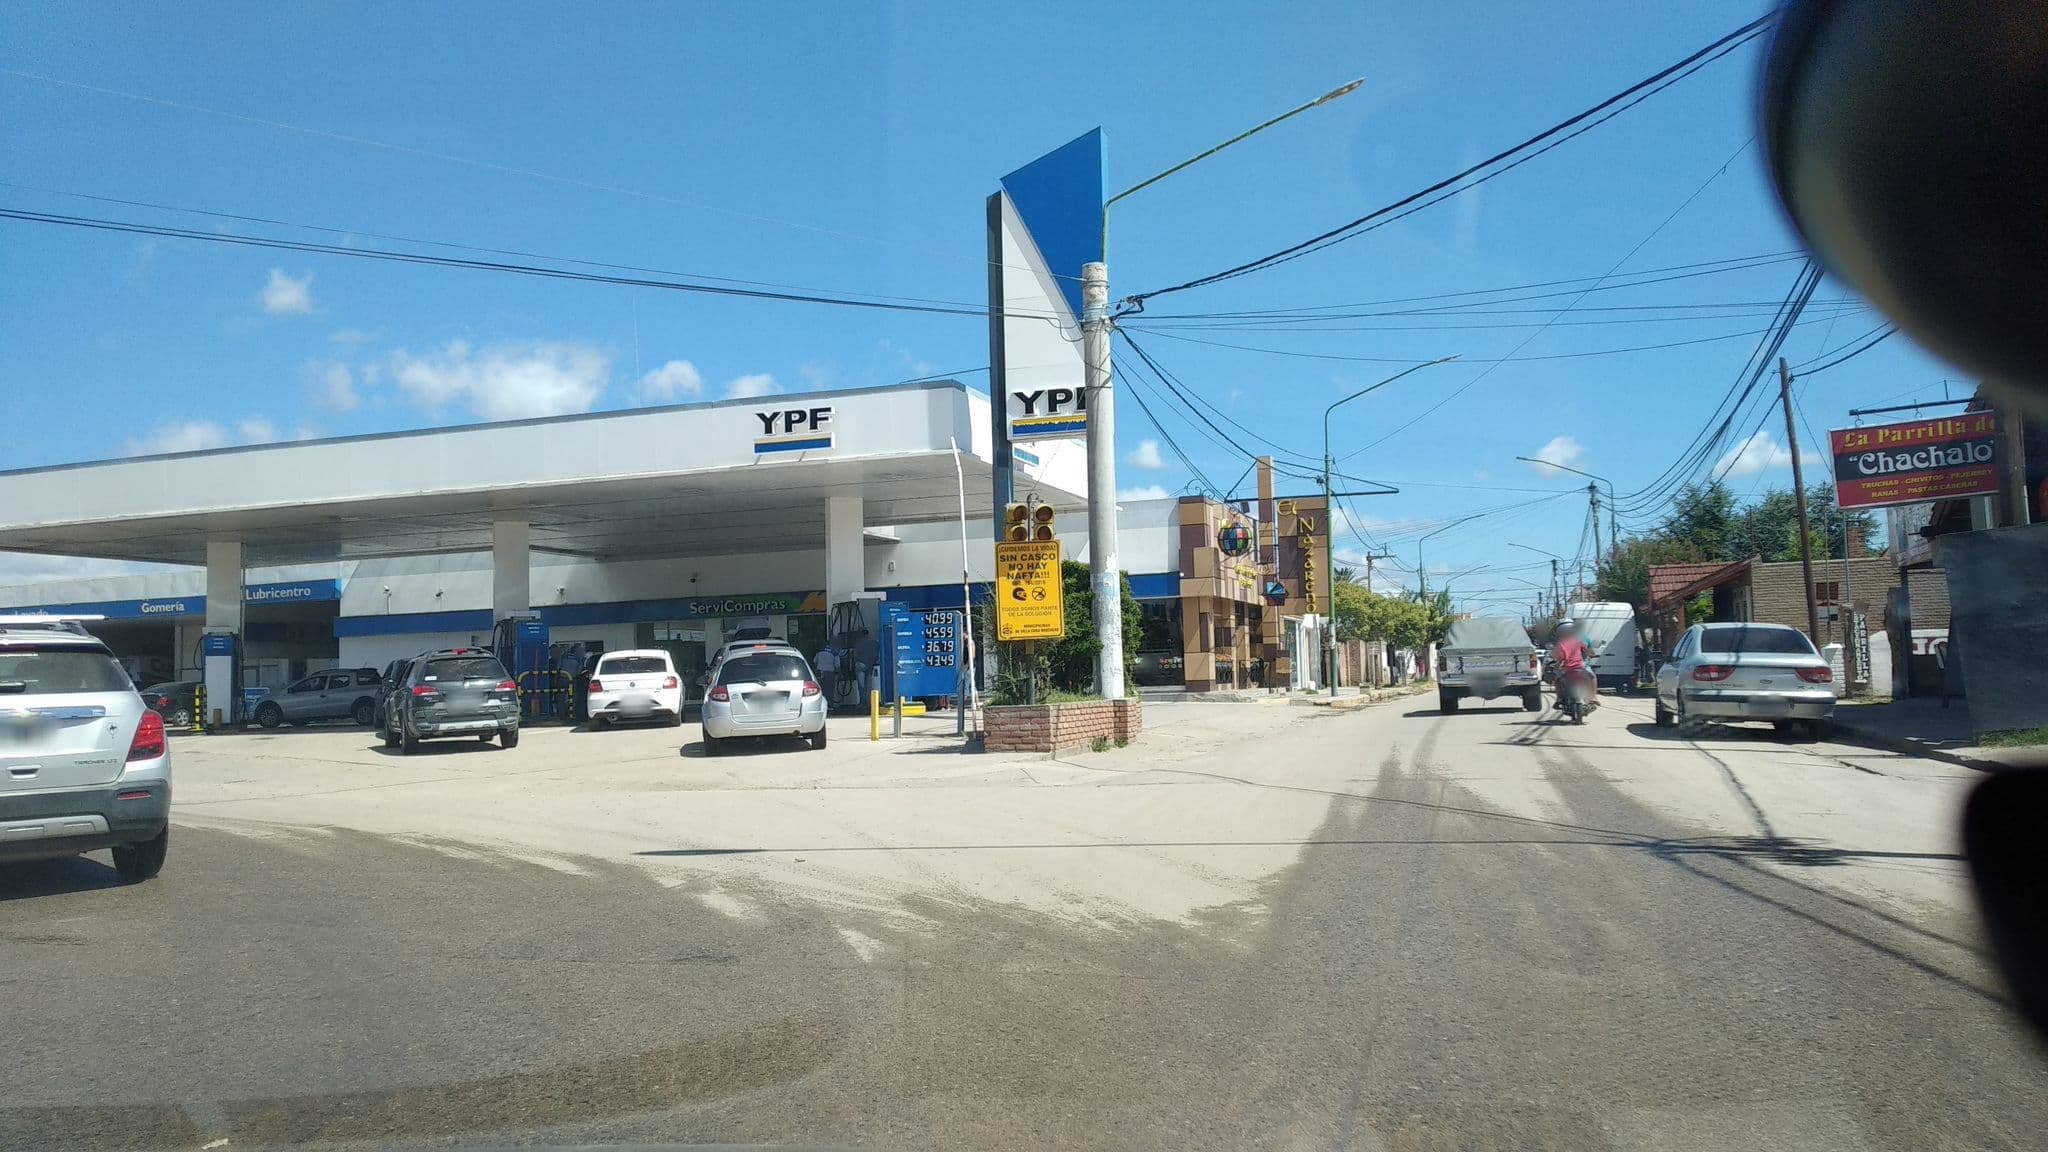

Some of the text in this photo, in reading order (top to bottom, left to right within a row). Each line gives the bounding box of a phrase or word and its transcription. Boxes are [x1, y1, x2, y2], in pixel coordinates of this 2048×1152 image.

[756, 407, 832, 434] YPF
[1843, 432, 1869, 447] La
[1877, 419, 1966, 444] Parrilla
[1871, 489, 1899, 498] RANAS
[1907, 484, 1938, 494] PASTAS
[999, 553, 1056, 562] SIN CASCO
[1008, 562, 1047, 571] NO HAY
[245, 586, 311, 600] Lubricentro
[141, 600, 185, 614] Gomería
[689, 600, 786, 614] ServiCompras
[1859, 613, 1869, 678] PARRILLA
